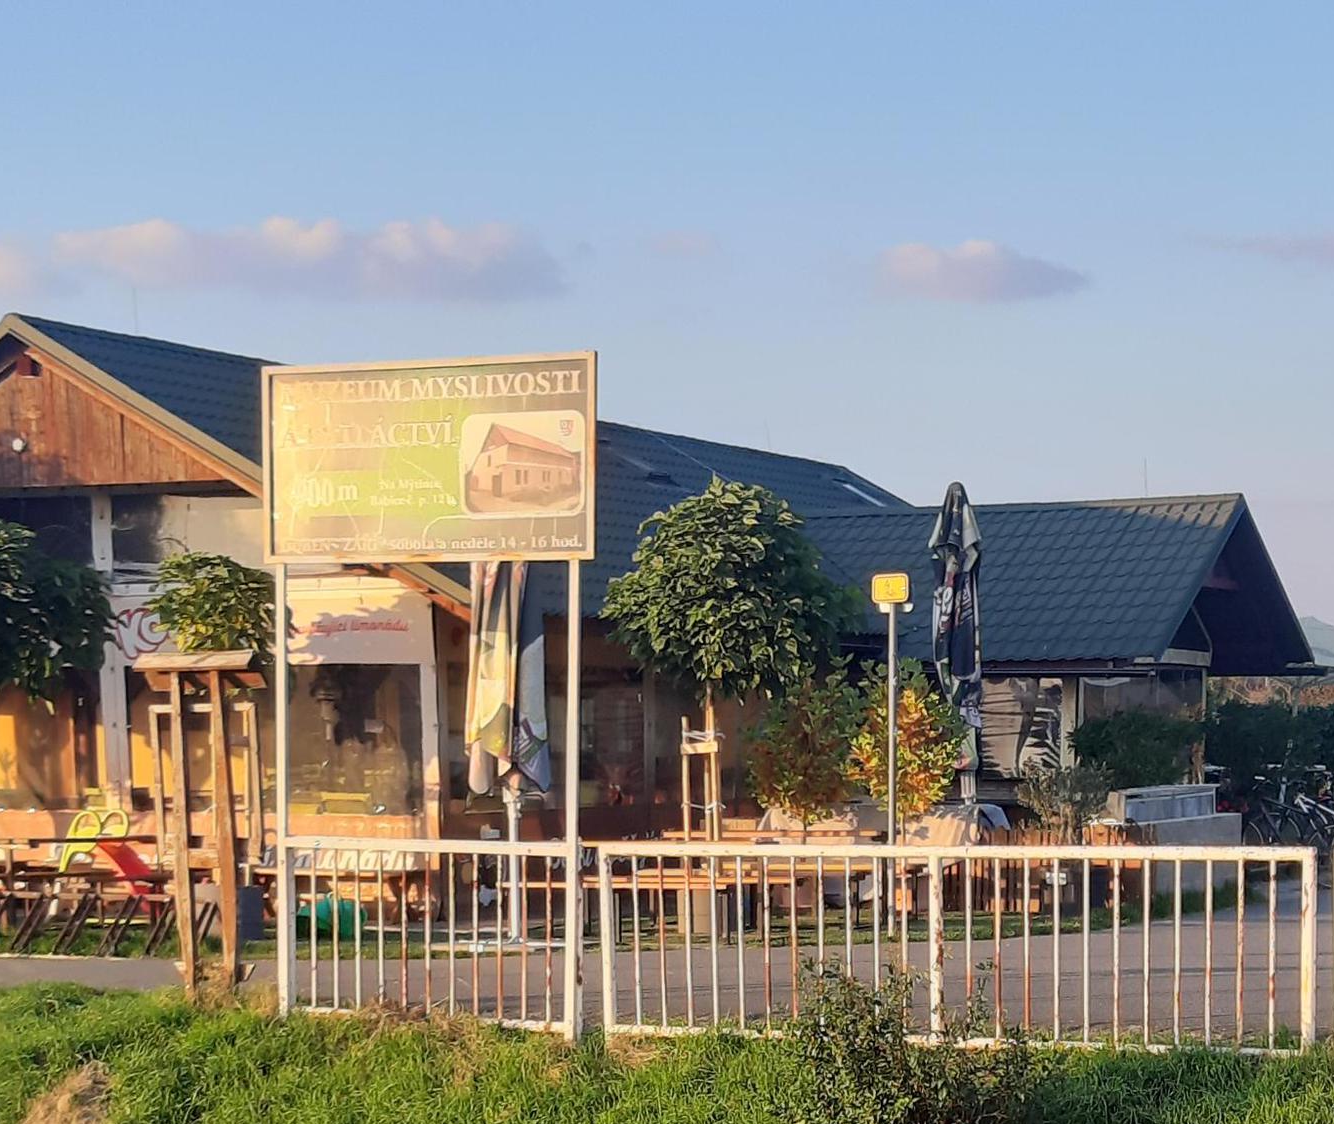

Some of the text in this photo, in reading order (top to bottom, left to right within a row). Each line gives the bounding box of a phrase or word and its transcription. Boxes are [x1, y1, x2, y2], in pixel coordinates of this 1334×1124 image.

[281, 369, 581, 404] ZEUM MYSLIVOSTI
[337, 484, 358, 501] m
[451, 537, 496, 549] neděle
[500, 536, 516, 548] 14
[531, 536, 547, 548] 16
[551, 534, 583, 548] hod.
